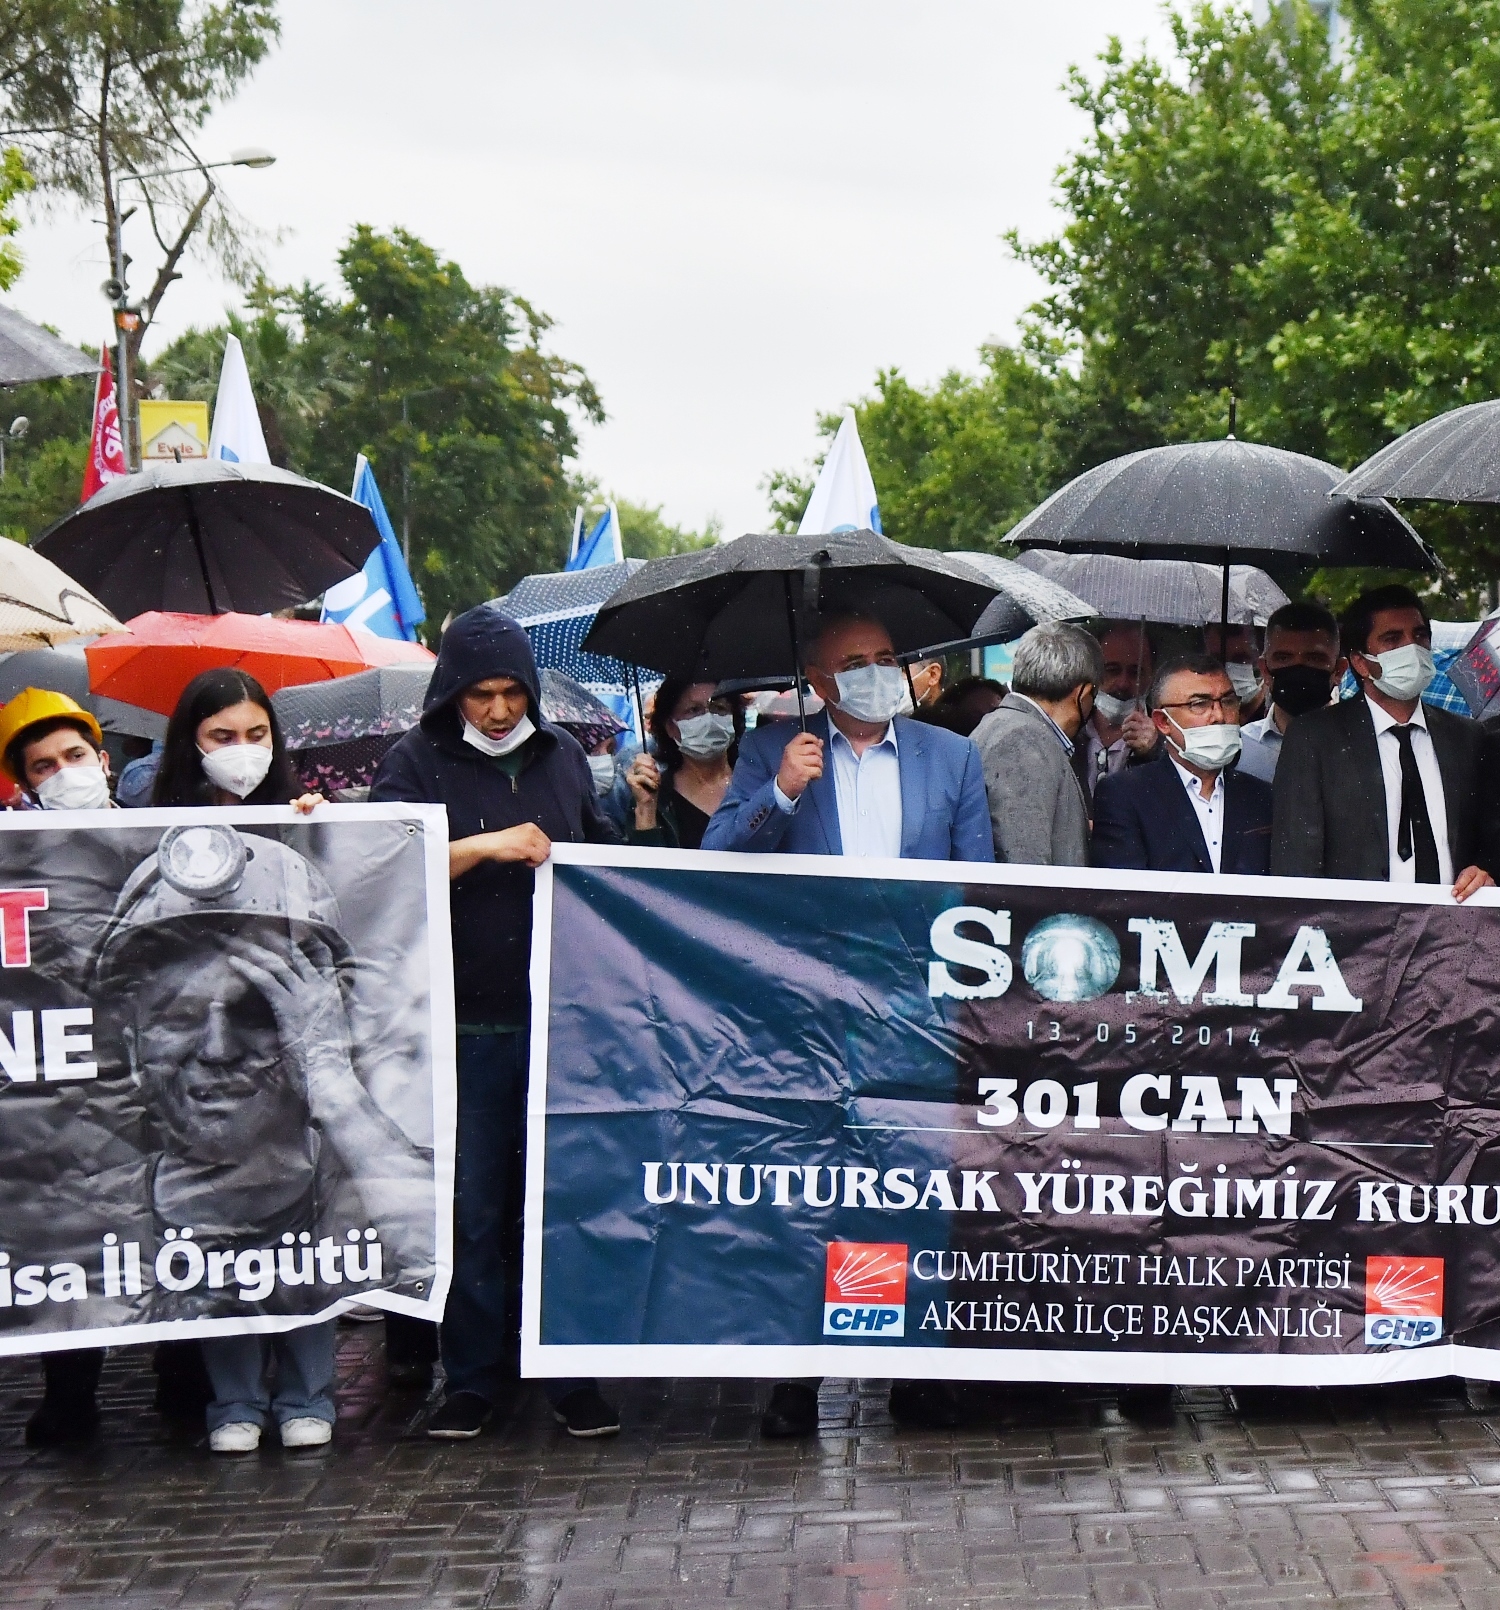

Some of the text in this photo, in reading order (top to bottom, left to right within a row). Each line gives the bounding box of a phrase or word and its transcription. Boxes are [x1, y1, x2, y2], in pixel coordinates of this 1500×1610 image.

[928, 905, 1363, 1013] SOMA
[1026, 1021, 1261, 1048] 13.05.2014
[976, 1073, 1297, 1135] 301 CAN
[641, 1160, 1001, 1213] UNUTURSAK
[1014, 1158, 1338, 1221] YÜREĞİMİZ
[102, 1232, 142, 1298] İl
[155, 1227, 383, 1302] Örgütü
[913, 1246, 1352, 1290] CUMHURİYET HALK PARTİSİ
[829, 1307, 899, 1331] CHP
[918, 1294, 1343, 1343] AKHİSAR İLÇE BAŞKANLIĞI
[1370, 1319, 1437, 1342] CHP
